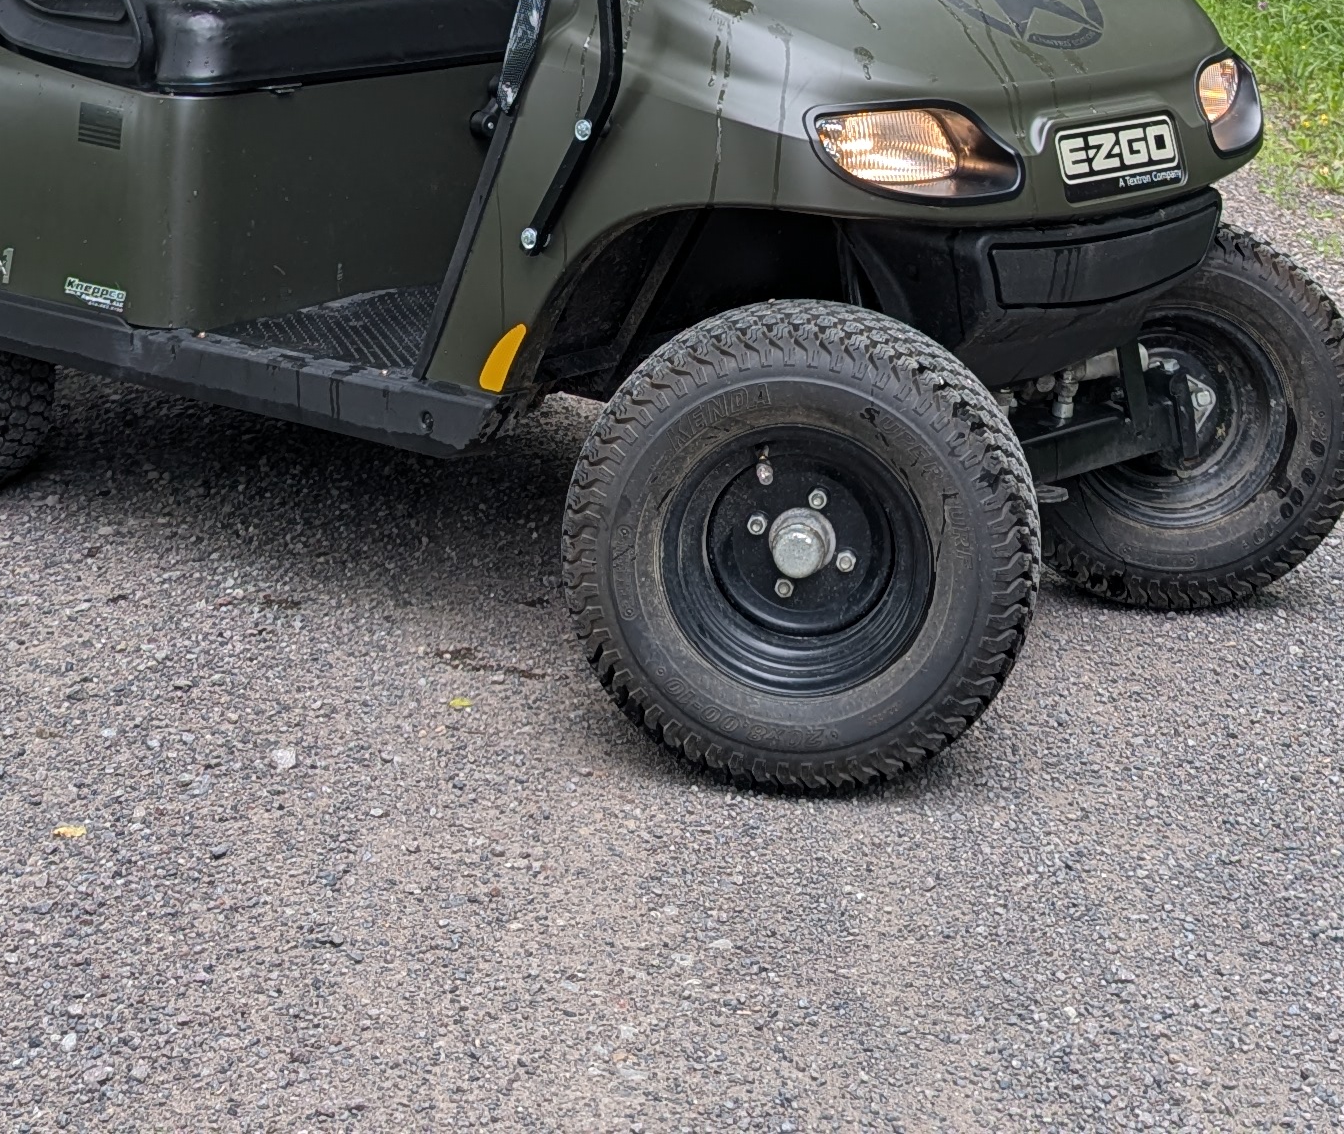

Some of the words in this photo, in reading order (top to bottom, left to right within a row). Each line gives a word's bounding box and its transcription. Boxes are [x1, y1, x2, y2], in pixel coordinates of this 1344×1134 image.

[1119, 178, 1126, 188] A
[1125, 174, 1151, 187] Textron
[1152, 169, 1182, 183] Company
[66, 278, 125, 300] Kneppco
[667, 383, 772, 453] KENDA
[859, 406, 944, 482] SUPER
[941, 486, 974, 571] TURF
